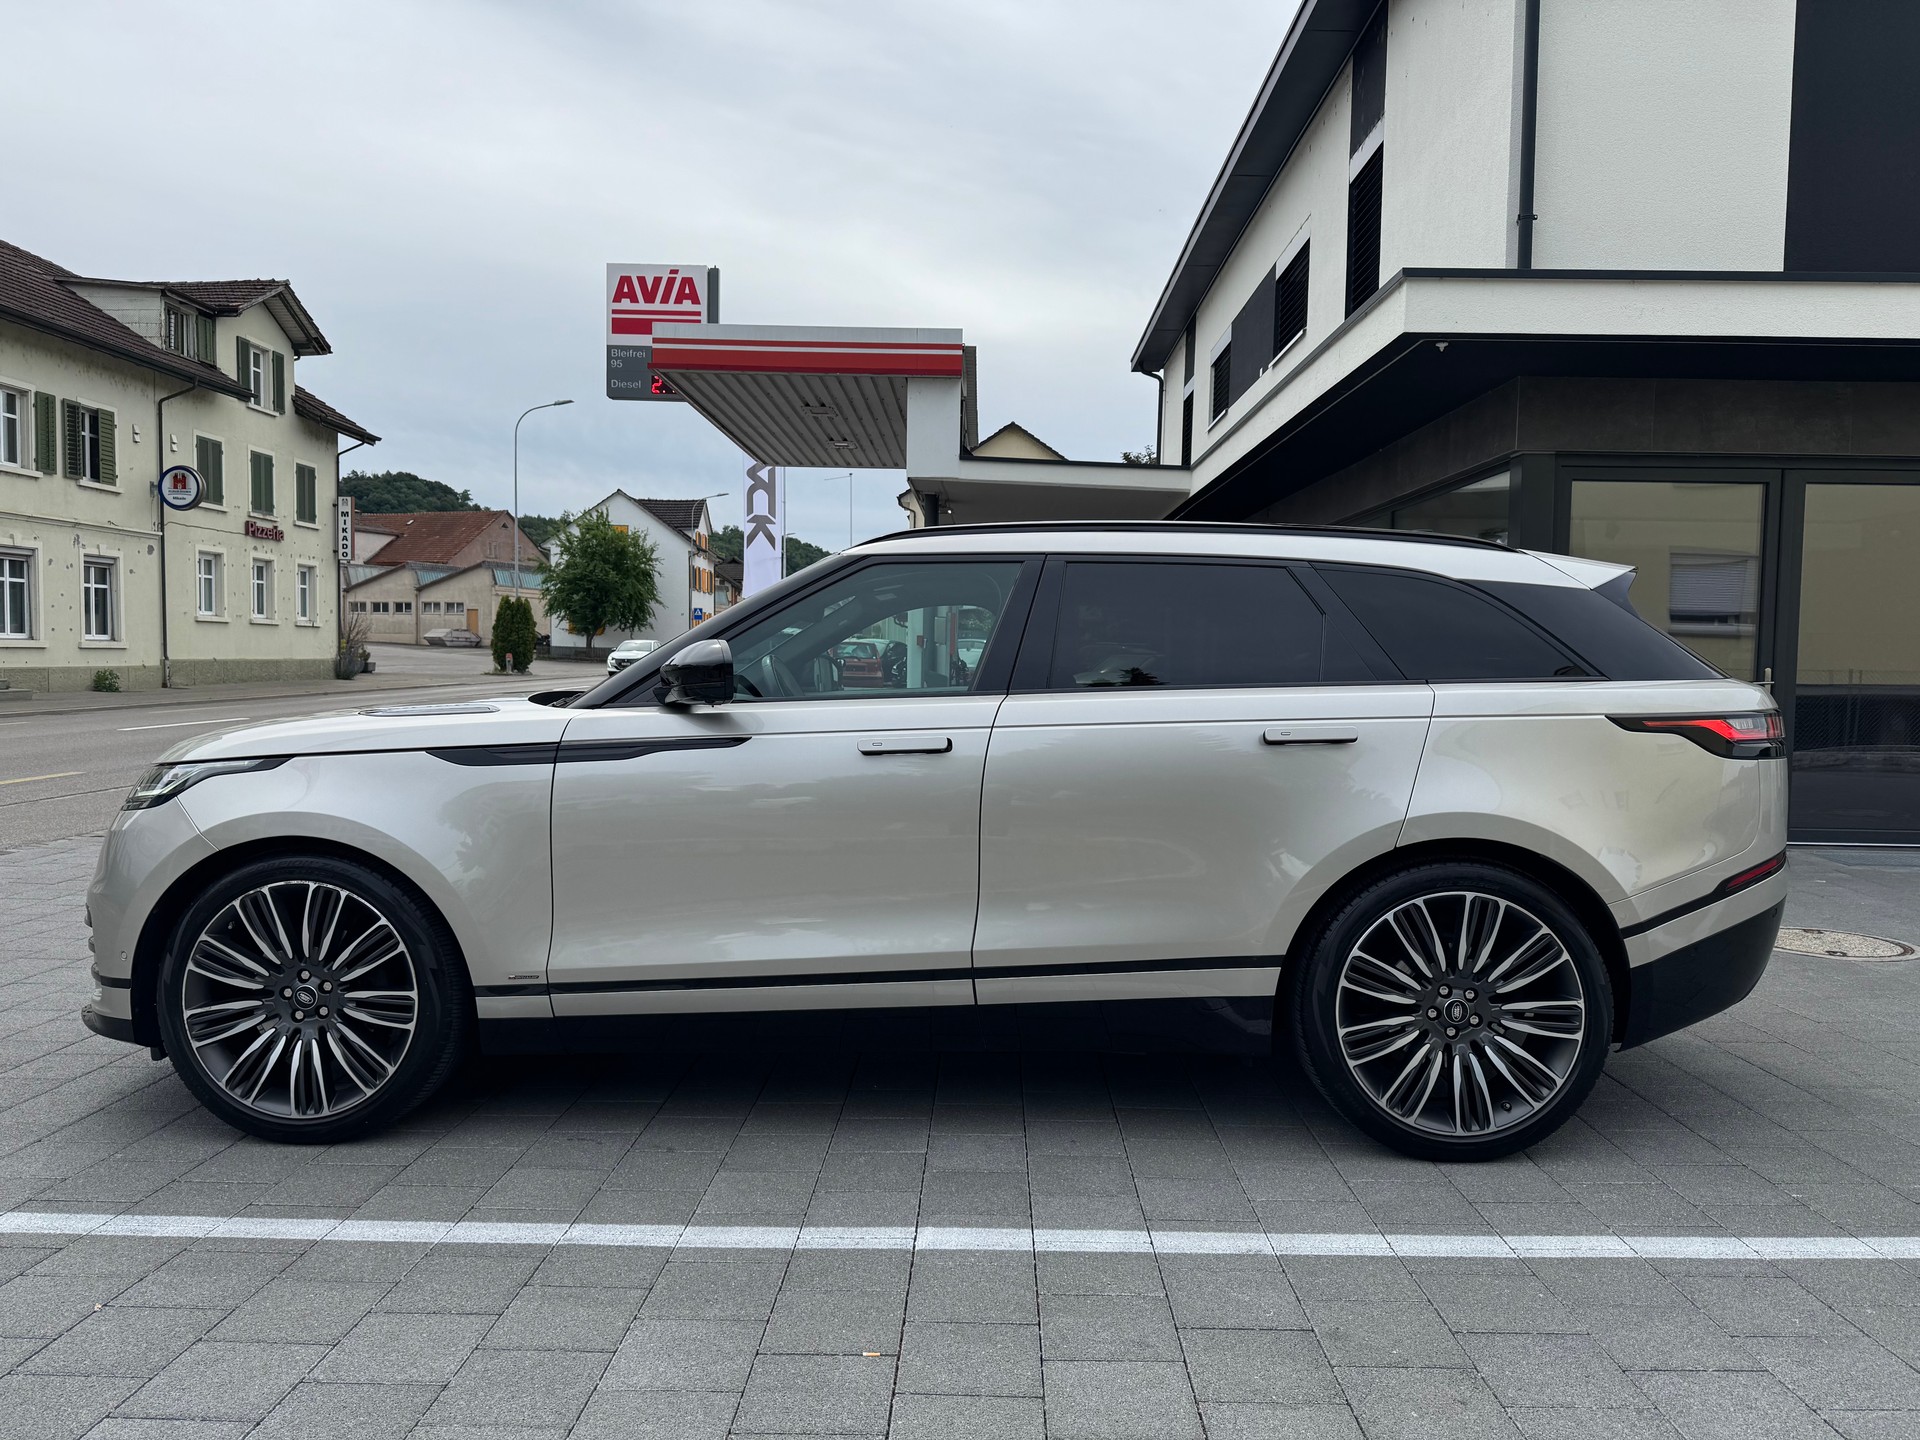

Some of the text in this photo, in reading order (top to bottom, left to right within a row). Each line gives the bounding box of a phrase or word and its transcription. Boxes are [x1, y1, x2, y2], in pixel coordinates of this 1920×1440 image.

[611, 349, 646, 358] Bleifrei
[611, 359, 623, 368] 95
[611, 379, 642, 389] Diesel
[247, 520, 285, 542] Pizzeria
[340, 511, 350, 558] MIKADO
